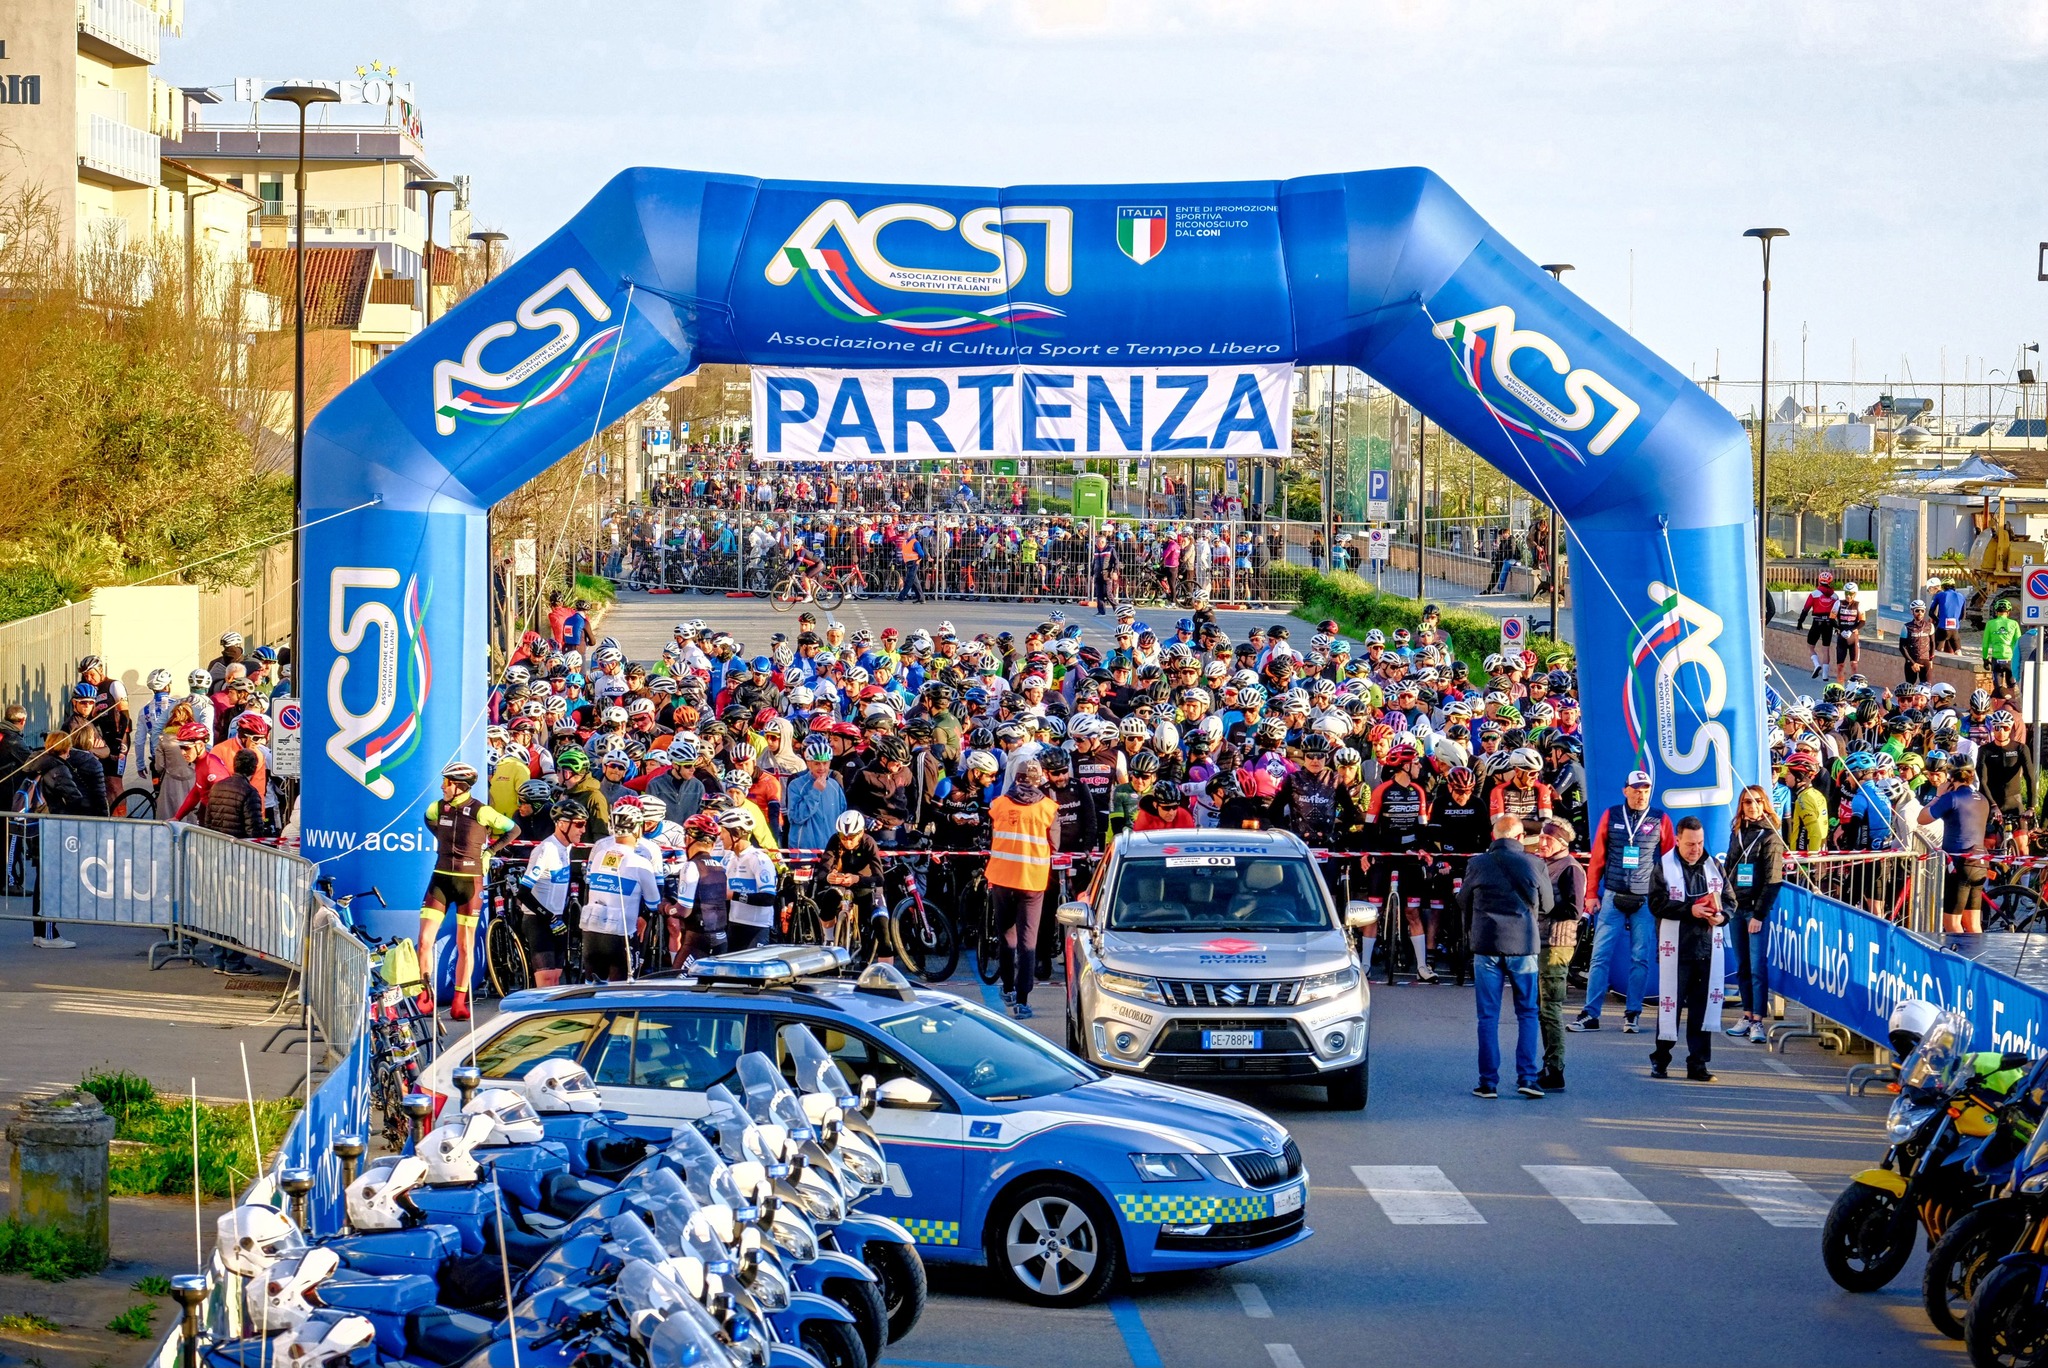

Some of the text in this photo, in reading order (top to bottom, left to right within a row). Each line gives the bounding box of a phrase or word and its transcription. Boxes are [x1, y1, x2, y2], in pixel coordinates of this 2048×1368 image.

[1122, 208, 1163, 217] ITALIA
[1215, 205, 1279, 213] PROMOZIONE
[764, 199, 1073, 296] ACSI
[1175, 229, 1221, 237] DAL CONI
[889, 272, 1002, 285] ASSOCIAZIONE CENTRI
[900, 280, 991, 292] SPORTIVI ITALIANI
[433, 267, 612, 436] ACSI
[505, 333, 571, 383] ASSOCIAZIONE CENTRI
[514, 342, 568, 381] SPORTIVI ITALIANI
[767, 331, 1281, 357] Associazione di Cultura Sport e Tempo Libero
[1432, 305, 1641, 456] ACSI
[1503, 374, 1569, 424] ASSOCIAZIONE CENTRI
[766, 373, 1280, 454] PARTENZA
[1506, 382, 1559, 423] SPORTIVI ITALIANI
[1372, 473, 1385, 497] P
[326, 566, 401, 800] ACSI
[381, 649, 389, 706] ASSOCIAZIONE
[1648, 581, 1734, 809] ACSI
[1663, 673, 1672, 731] ASSOCIAZIONE
[606, 856, 617, 866] 39
[1184, 846, 1268, 854] SUZUKI
[1207, 857, 1232, 865] 00
[1118, 1007, 1154, 1025] GIACOBAZZI
